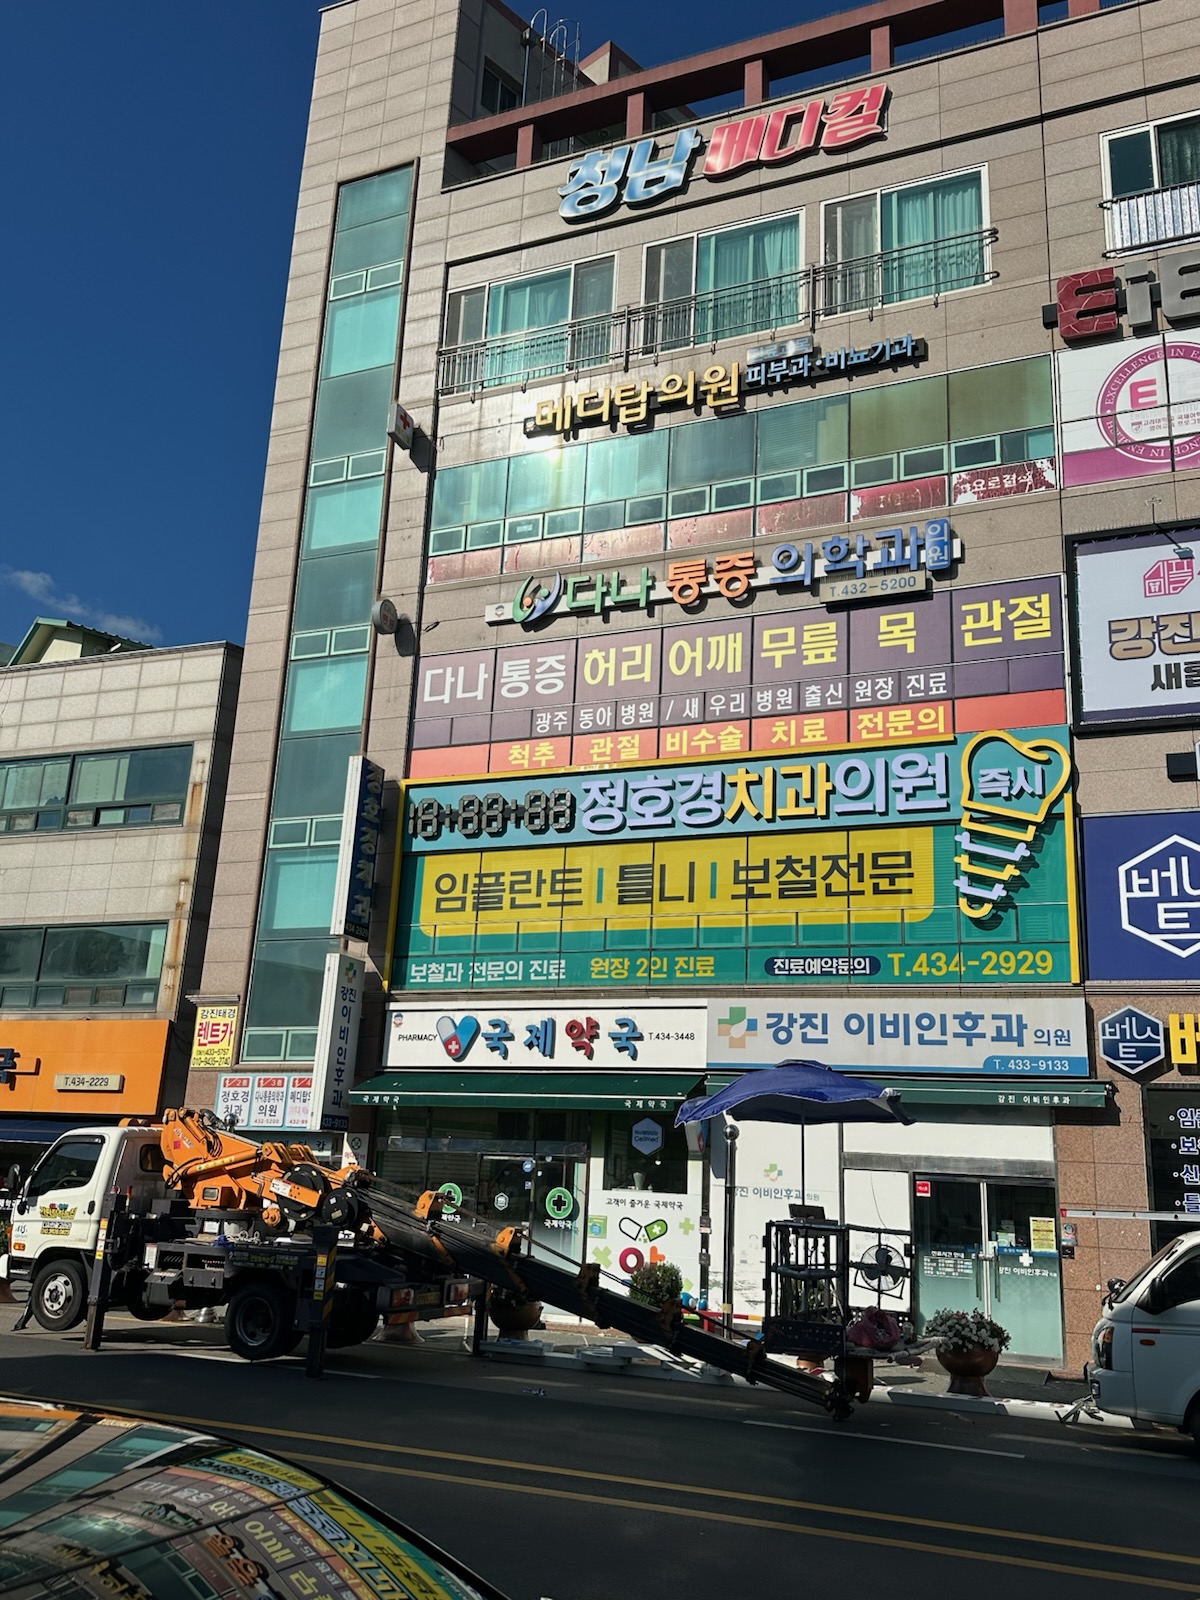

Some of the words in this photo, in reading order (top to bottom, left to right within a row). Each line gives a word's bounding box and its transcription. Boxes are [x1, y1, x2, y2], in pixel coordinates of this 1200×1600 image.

[1105, 350, 1164, 405] EXCELLENCE
[1170, 348, 1185, 357] IN
[534, 361, 740, 433] 메디탑의원
[829, 575, 917, 598] T.432-5200
[423, 662, 488, 704] 다나
[500, 653, 567, 698] 통증
[583, 642, 653, 687] 허리
[668, 632, 743, 677] 어깨
[760, 620, 839, 669] 무릎
[877, 611, 917, 654] 목
[960, 593, 1052, 647] 관절
[535, 711, 568, 734] 광주
[579, 706, 612, 729] 동아
[621, 702, 653, 725] 병원
[683, 697, 699, 719] 새
[709, 691, 745, 714] 우리
[756, 687, 793, 711] 병원
[804, 682, 843, 707] 출신
[854, 677, 894, 702] 원장
[906, 672, 947, 697] 진료
[507, 742, 555, 769] 척추
[589, 734, 640, 762] 관절
[666, 725, 744, 754] 비수술
[771, 717, 828, 747] 치료
[856, 705, 945, 740] 전문의
[978, 765, 1044, 797] 즉시
[435, 867, 583, 913] 임플란트
[616, 861, 695, 907] 틀니
[731, 850, 914, 900] 보철전문
[410, 962, 464, 983] 보철과
[468, 959, 524, 982] 전문의
[529, 958, 566, 981] 진료
[590, 957, 630, 980] 원장
[636, 956, 668, 979] 2인
[674, 955, 715, 978] 진료
[887, 950, 1053, 977] T.434-2929
[340, 986, 357, 1003] 강진
[197, 1020, 233, 1047] 렌트카
[397, 1033, 438, 1042] PHARMACY
[481, 1015, 642, 1060] 국제약국
[648, 1032, 695, 1041] T.434-3448
[765, 1011, 829, 1046] 강진
[843, 1010, 1028, 1047] 이비인후과
[1033, 1028, 1072, 1047] 의원
[332, 1005, 352, 1109] 이비인후과
[1007, 1058, 1070, 1072] 433-9133
[64, 1076, 109, 1087] T.434-2229
[221, 1090, 250, 1103] 정호경
[997, 1094, 1016, 1104] 강진
[1022, 1095, 1071, 1105] 이비인후과
[257, 1104, 278, 1117] 의원
[653, 1199, 684, 1211] 국제약국
[441, 1213, 462, 1224] 제약국
[543, 1218, 573, 1230] 국제약국
[1013, 1266, 1049, 1278] 이비인후과
